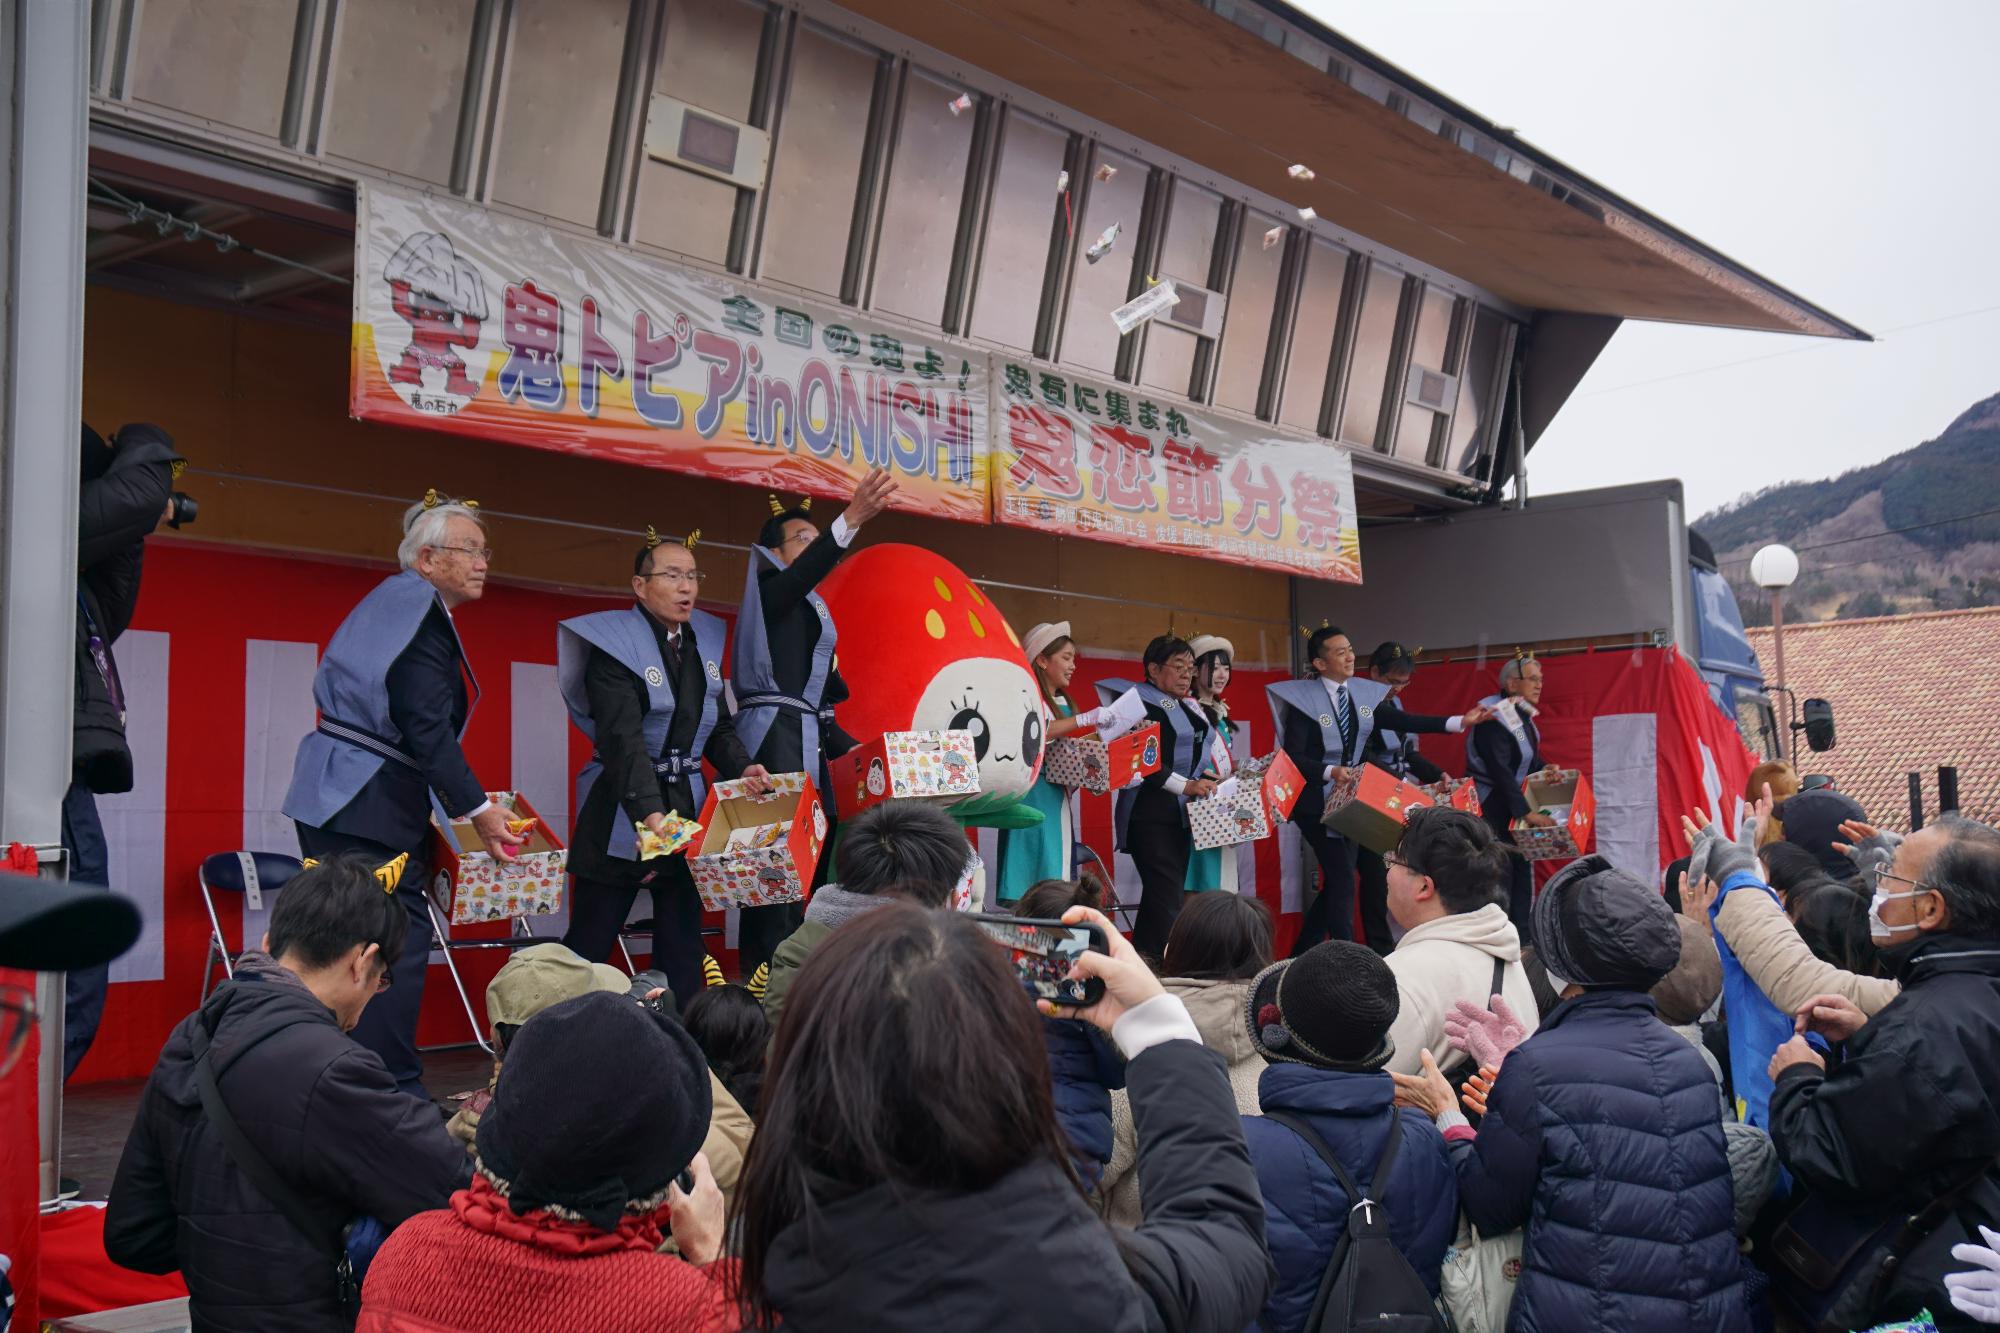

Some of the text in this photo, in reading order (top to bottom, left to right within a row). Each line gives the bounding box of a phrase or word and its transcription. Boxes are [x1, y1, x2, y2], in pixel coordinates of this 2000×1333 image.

[411, 390, 458, 413] 鬼の石丸
[1005, 363, 1192, 439] 鬼石に集まれ
[1007, 401, 1344, 552] 鬼恋節分祭
